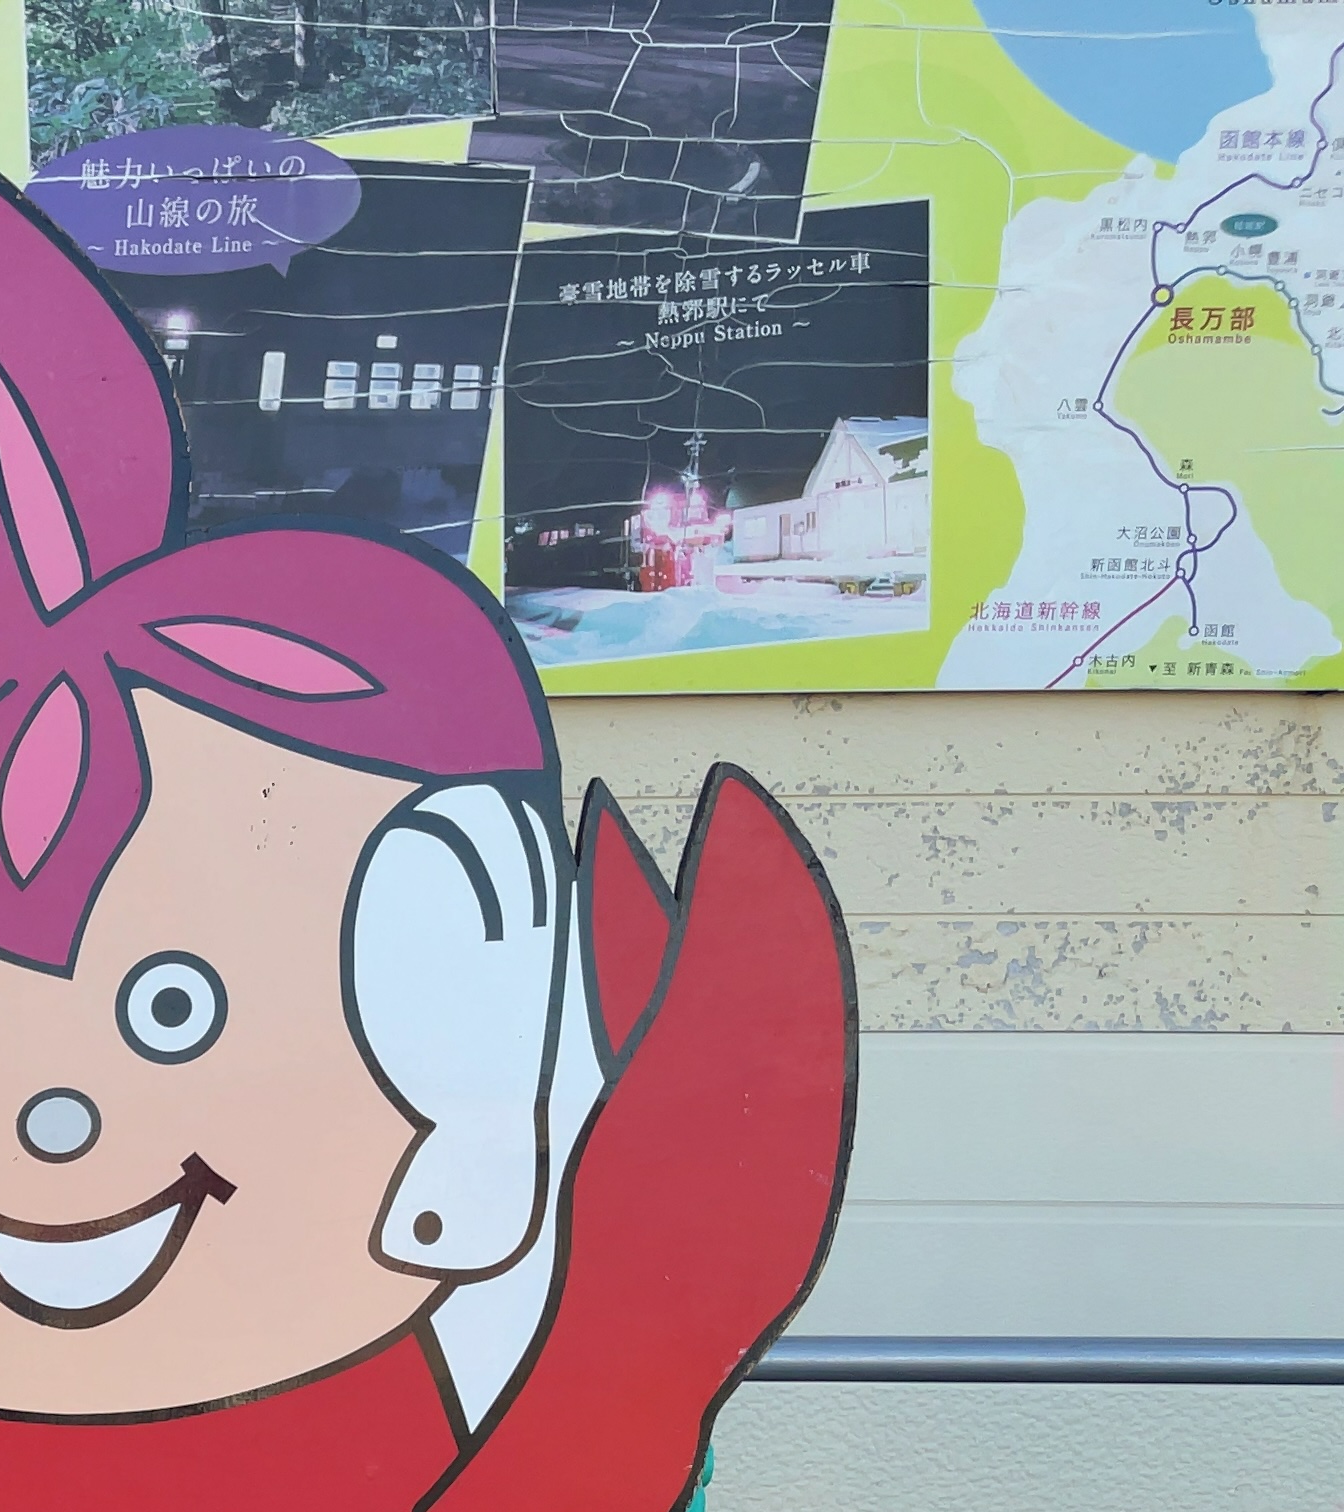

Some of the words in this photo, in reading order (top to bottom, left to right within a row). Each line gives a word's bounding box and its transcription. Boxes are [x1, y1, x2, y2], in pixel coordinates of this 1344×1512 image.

[79, 154, 306, 191] 魅力いっぱいの
[1298, 187, 1343, 199] ニセコ
[126, 194, 258, 229] 山線の旅
[113, 238, 202, 256] Hakodate
[211, 236, 252, 253] Line
[558, 252, 871, 306] 豪雪地帯を除雪するラッセル車
[1169, 306, 1257, 332] 長万部
[644, 329, 705, 350] Neppu
[713, 320, 783, 343] Station
[1167, 333, 1252, 345] Oshamambe
[1178, 458, 1194, 472] 森
[1115, 526, 1181, 540] 大沼公園
[1089, 557, 1171, 572] 新函館北斗
[969, 600, 1102, 621] 北海道新幹線
[1203, 623, 1236, 639] 函館
[1088, 654, 1137, 669] 木古内
[1162, 662, 1178, 676] 至
[1187, 662, 1235, 677] 新青森
